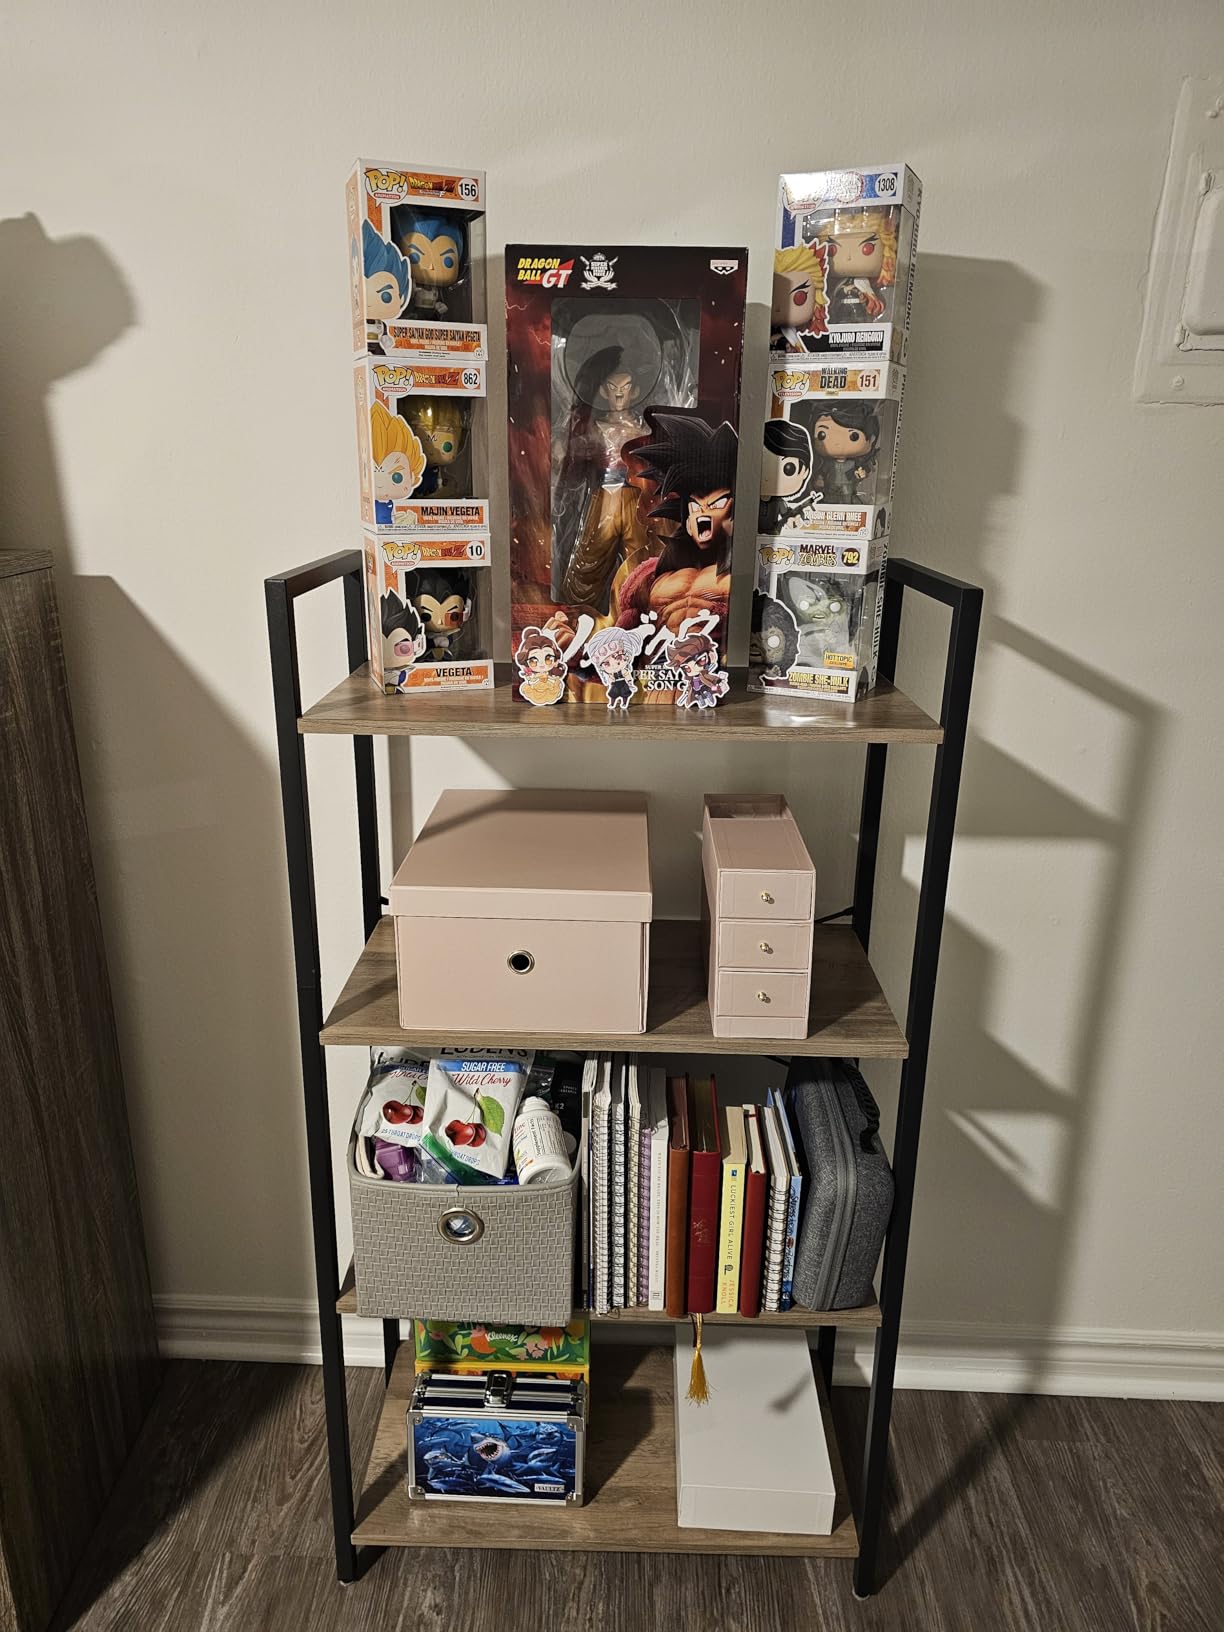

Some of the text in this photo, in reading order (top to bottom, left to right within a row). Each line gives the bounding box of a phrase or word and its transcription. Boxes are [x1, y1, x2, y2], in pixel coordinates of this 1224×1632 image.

[364, 168, 407, 194] POP!
[877, 177, 895, 192] 1308
[459, 183, 477, 197] 156
[517, 258, 560, 269] DRAGON
[517, 269, 573, 288] BALL GT
[393, 326, 407, 338] SUPER
[408, 327, 424, 339] SAIYAN
[425, 328, 434, 340] GOD
[434, 328, 448, 340] SUPER
[449, 329, 464, 341] SAIYAN
[465, 330, 481, 342] VEGETA
[828, 331, 884, 344] KYOJURO RENGOKU
[372, 364, 413, 387] POP!
[821, 367, 848, 375] WALKING
[463, 373, 478, 385] 862
[771, 369, 810, 391] POP!
[820, 376, 847, 389] DEAD
[860, 375, 877, 388] 151
[421, 506, 480, 516] MAJIN VEGETA
[381, 542, 420, 561] POP!
[468, 545, 483, 556] 10
[758, 546, 794, 566] POP!
[800, 544, 836, 555] MARVEL
[798, 553, 838, 567] ZOMBIES
[843, 551, 859, 564] 792
[837, 655, 853, 663] TOPIC
[435, 667, 472, 677] VEGETA
[647, 681, 675, 691] SON
[789, 672, 814, 684] ZOMBIE
[815, 674, 849, 687] SHE-HULK
[461, 1062, 506, 1072] SUGAR FREE
[452, 1073, 512, 1087] Wild Cherry
[729, 1184, 737, 1218] LUCKIEST
[485, 1331, 518, 1342] Kleenex
